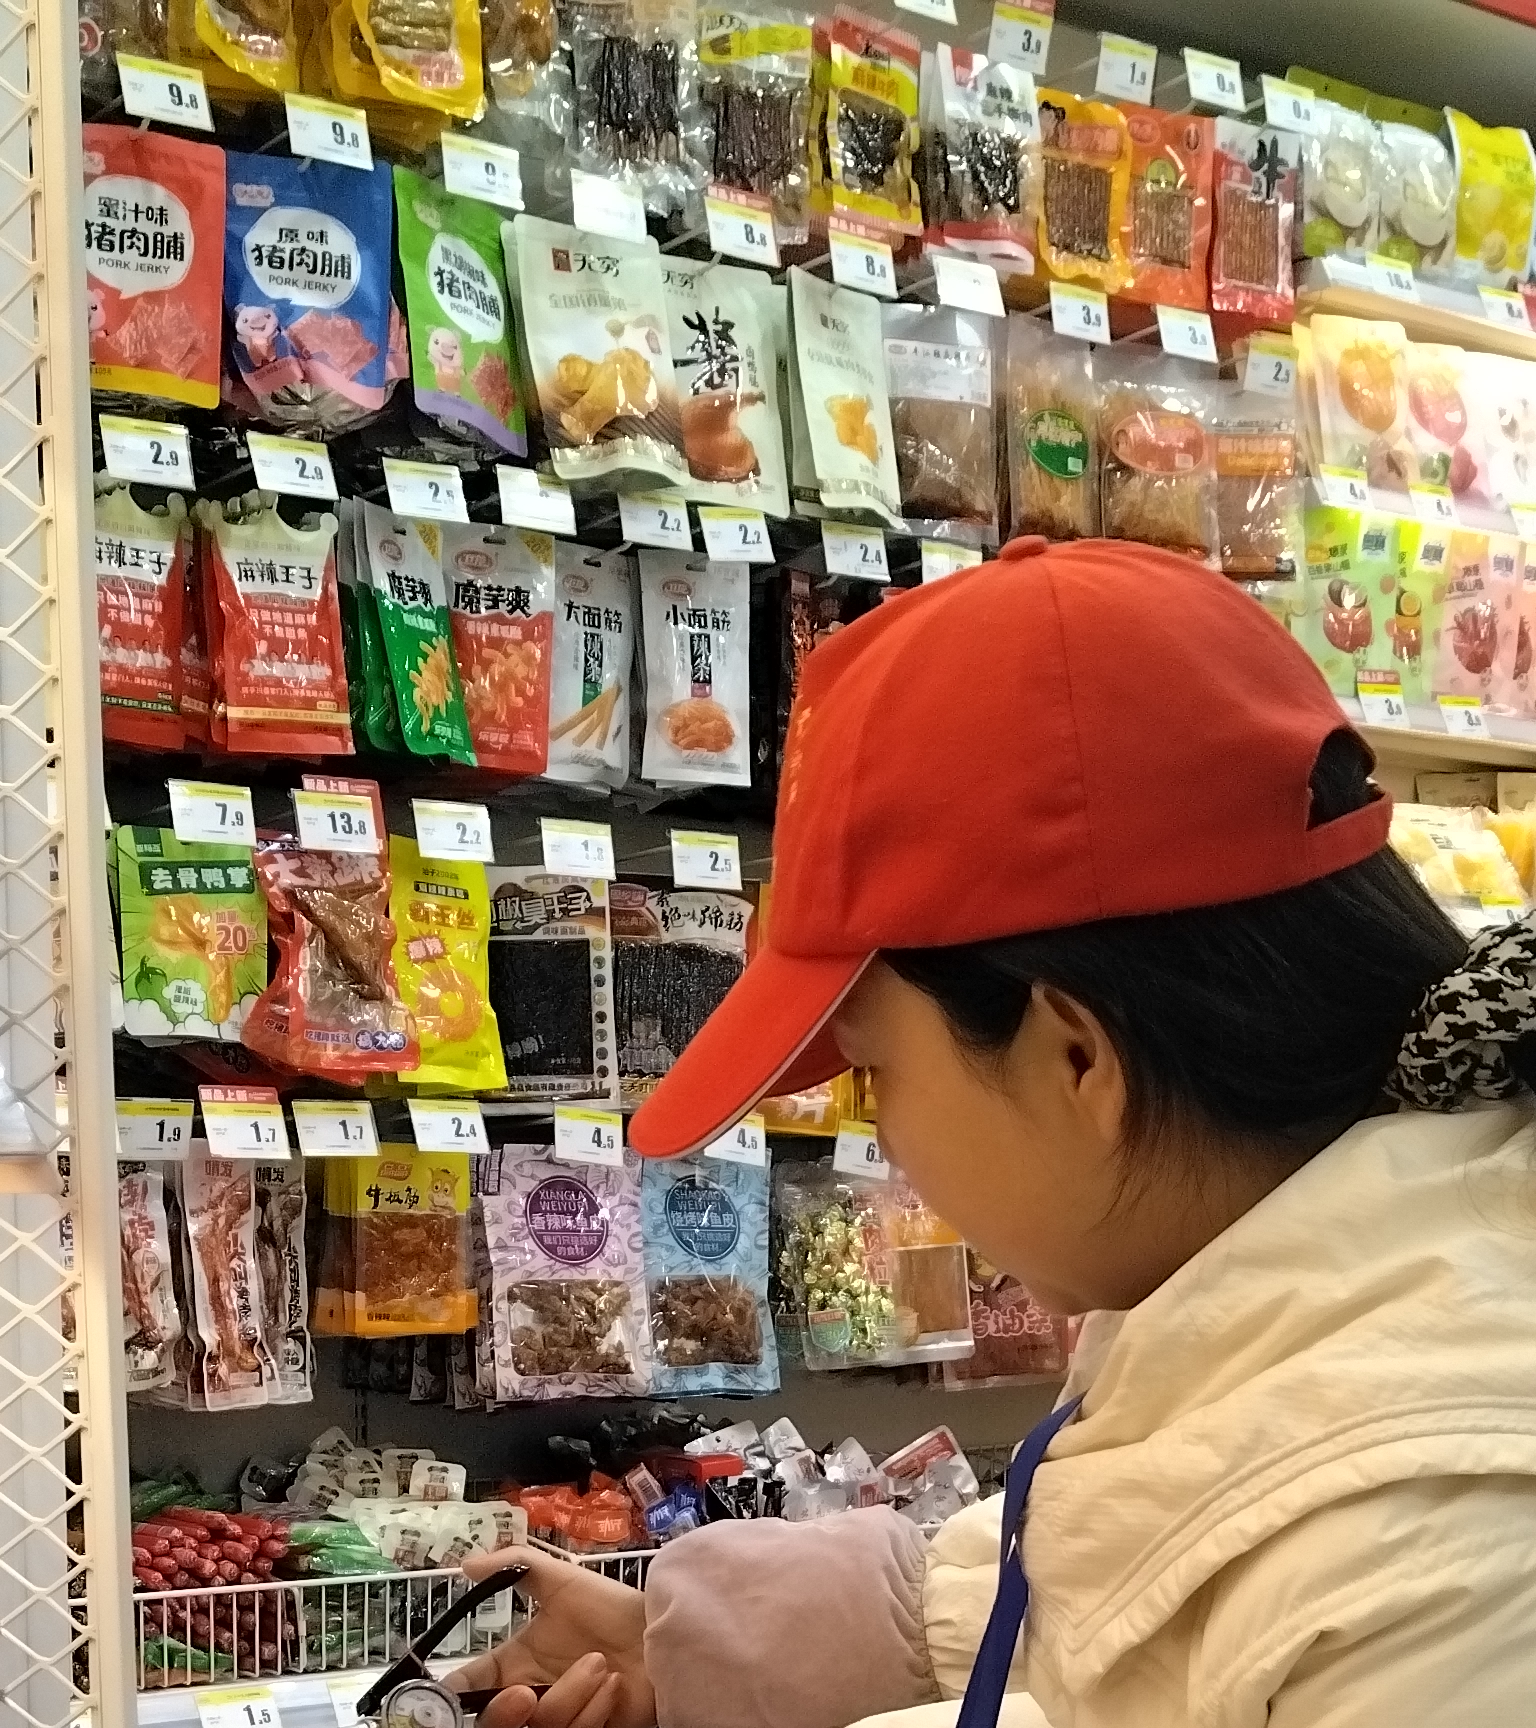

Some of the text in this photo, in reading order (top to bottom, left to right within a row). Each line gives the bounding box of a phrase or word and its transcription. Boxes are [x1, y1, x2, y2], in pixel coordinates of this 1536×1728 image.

[276, 227, 330, 246] 原味
[98, 257, 171, 276] PORK JERKY
[251, 244, 353, 280] 猪肉脯
[268, 274, 338, 294] PORK JERKY
[236, 558, 318, 590] 麻辣王子
[665, 604, 732, 633] 小面筋
[215, 802, 245, 828] 7.9
[150, 866, 251, 891] 去骨鸭掌
[249, 1120, 277, 1144] 1.7
[338, 1118, 364, 1142] 1.7
[451, 1115, 477, 1139] 2.4
[591, 1126, 615, 1151] 4.5
[736, 1127, 758, 1151] 4.5
[538, 1189, 585, 1201] XIANGLA
[242, 1704, 271, 1728] 1.5
